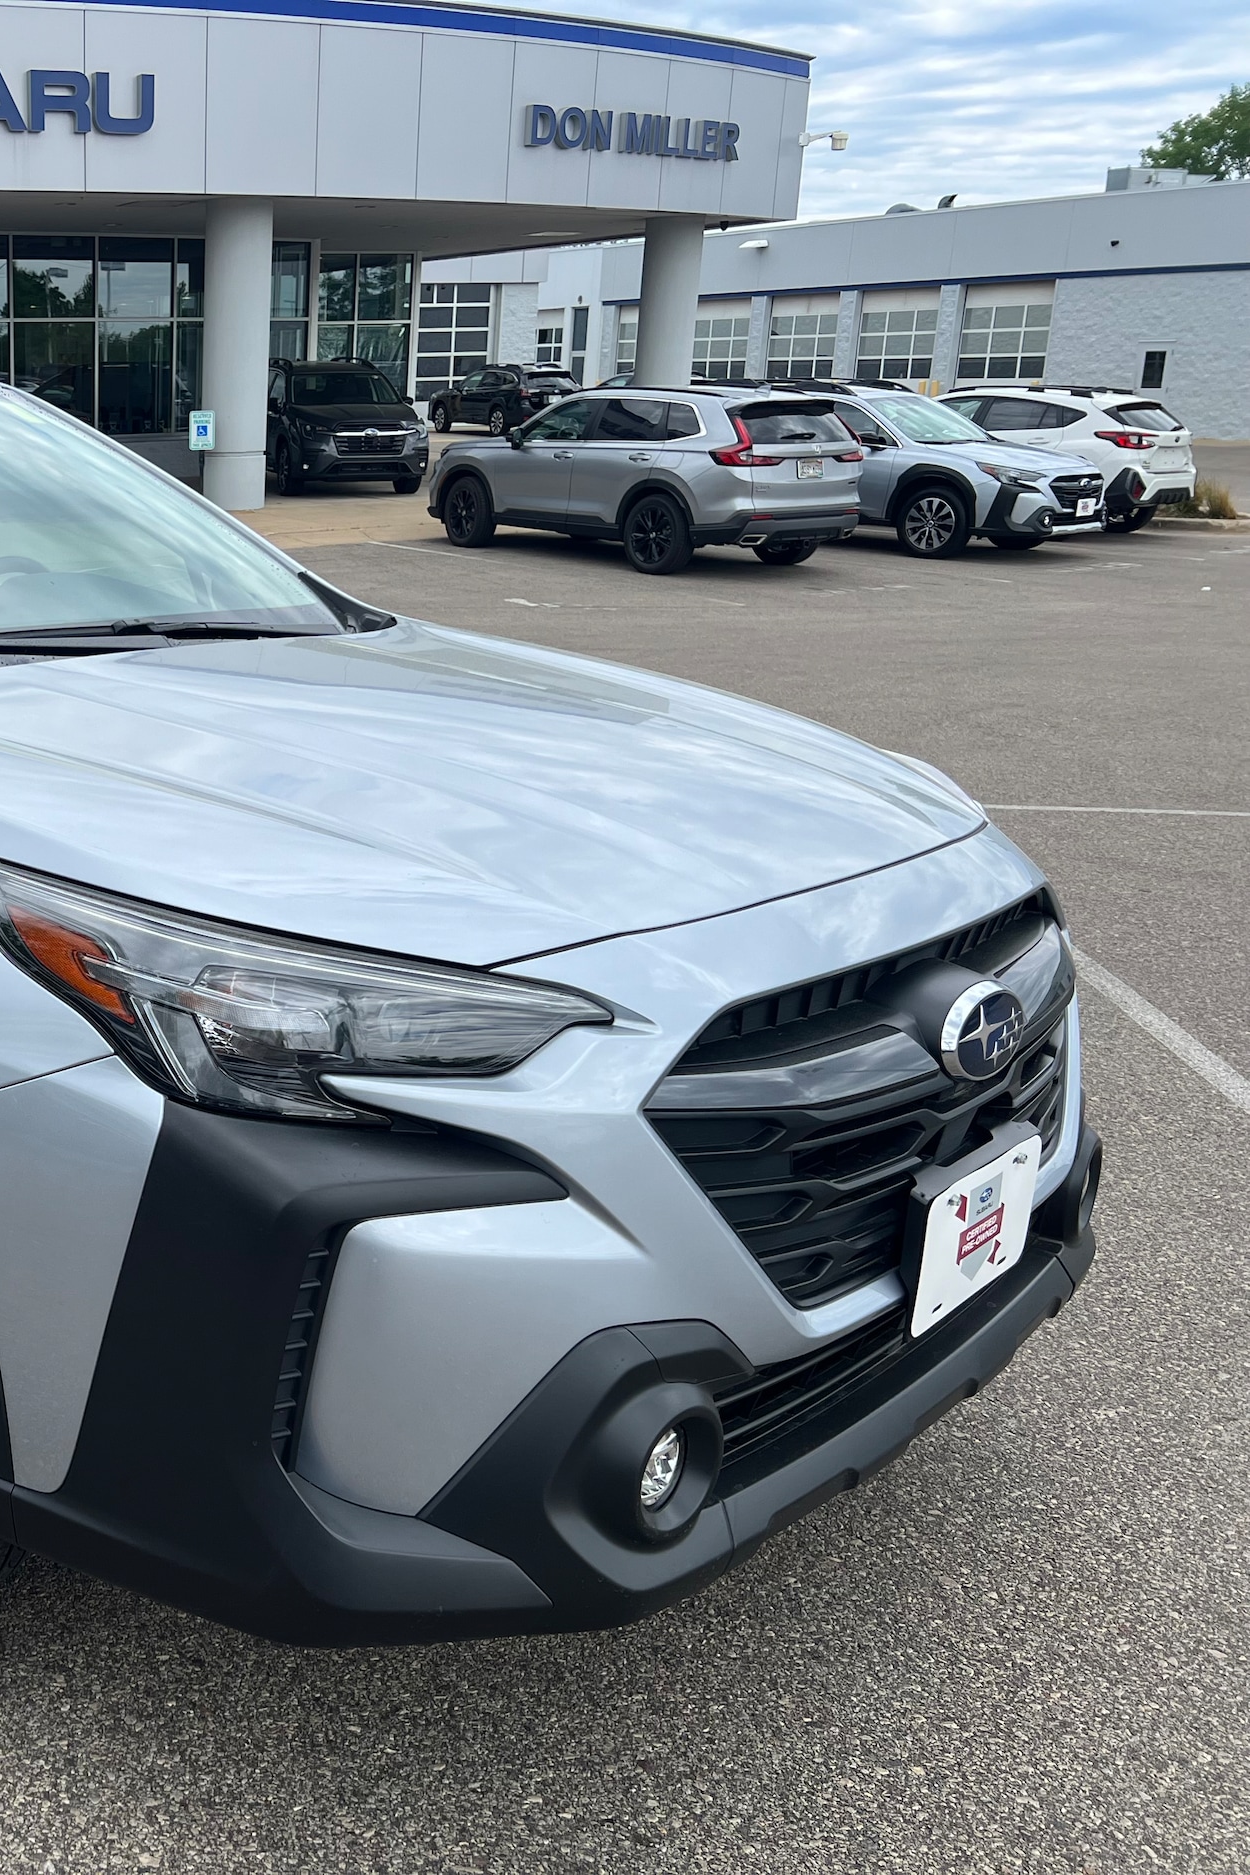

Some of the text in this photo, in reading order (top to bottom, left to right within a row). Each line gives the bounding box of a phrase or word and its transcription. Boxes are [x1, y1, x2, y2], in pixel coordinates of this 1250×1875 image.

[524, 104, 741, 162] DON MILLER
[961, 1223, 999, 1255] PRE-OWNED
[966, 1214, 997, 1241] CERTIFIED
